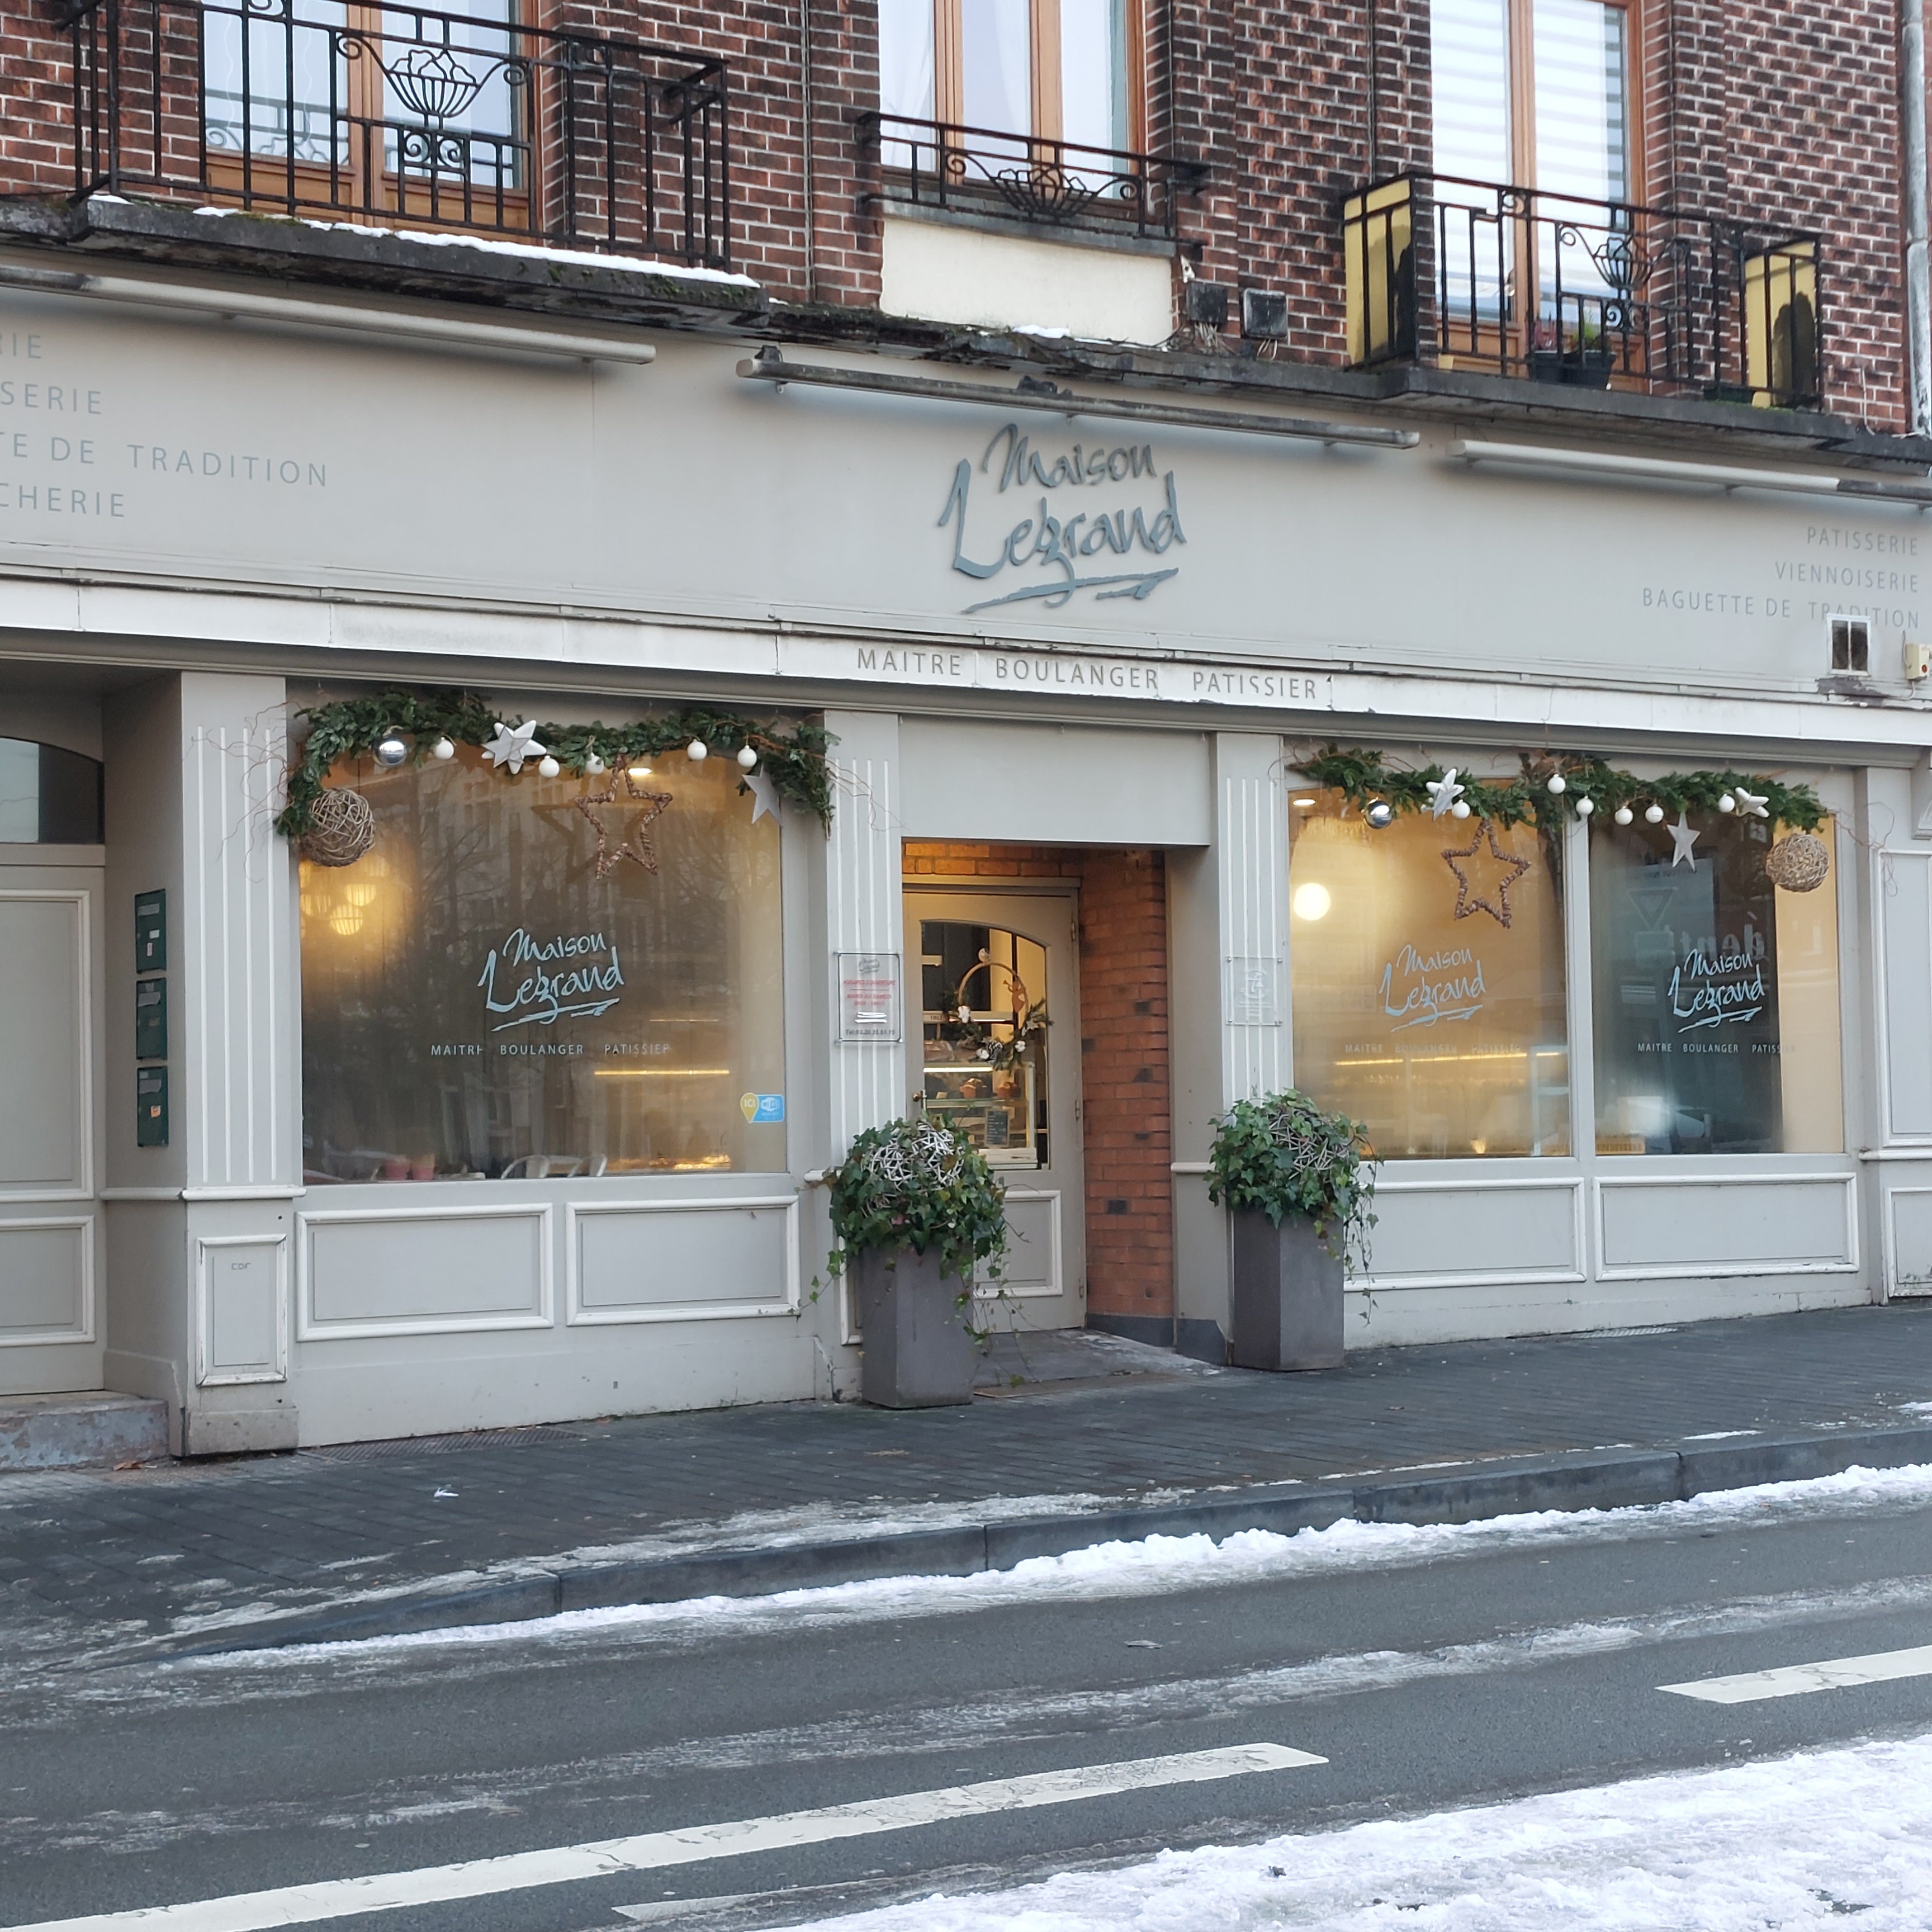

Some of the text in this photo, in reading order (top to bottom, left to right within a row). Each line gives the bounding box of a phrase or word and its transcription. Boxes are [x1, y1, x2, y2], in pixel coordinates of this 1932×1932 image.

[51, 437, 94, 464] DE
[127, 444, 326, 486] TRADITION
[982, 423, 1156, 493] Maison
[938, 458, 1187, 608] Legrand
[1807, 526, 1918, 556] PATISSERIE
[1775, 561, 1918, 593] VIENNOISERIE
[1642, 588, 1754, 615] BAGUETTE
[1766, 598, 1791, 617] DE
[858, 648, 1316, 700] MAITRE BOULANGER PATISSIER
[503, 928, 606, 967] Maison
[1396, 944, 1473, 977] Maison
[1684, 949, 1753, 980] Maison
[477, 946, 624, 1024] Legrand
[1378, 959, 1486, 1026] Legrand
[1668, 964, 1764, 1027] Legrand
[500, 1044, 584, 1055] BOULANGER
[1344, 1043, 1384, 1054] MAITRE
[1637, 1043, 1673, 1053] MAITRE
[1683, 1043, 1739, 1053] BOULANGER
[744, 1099, 755, 1108] ICI
